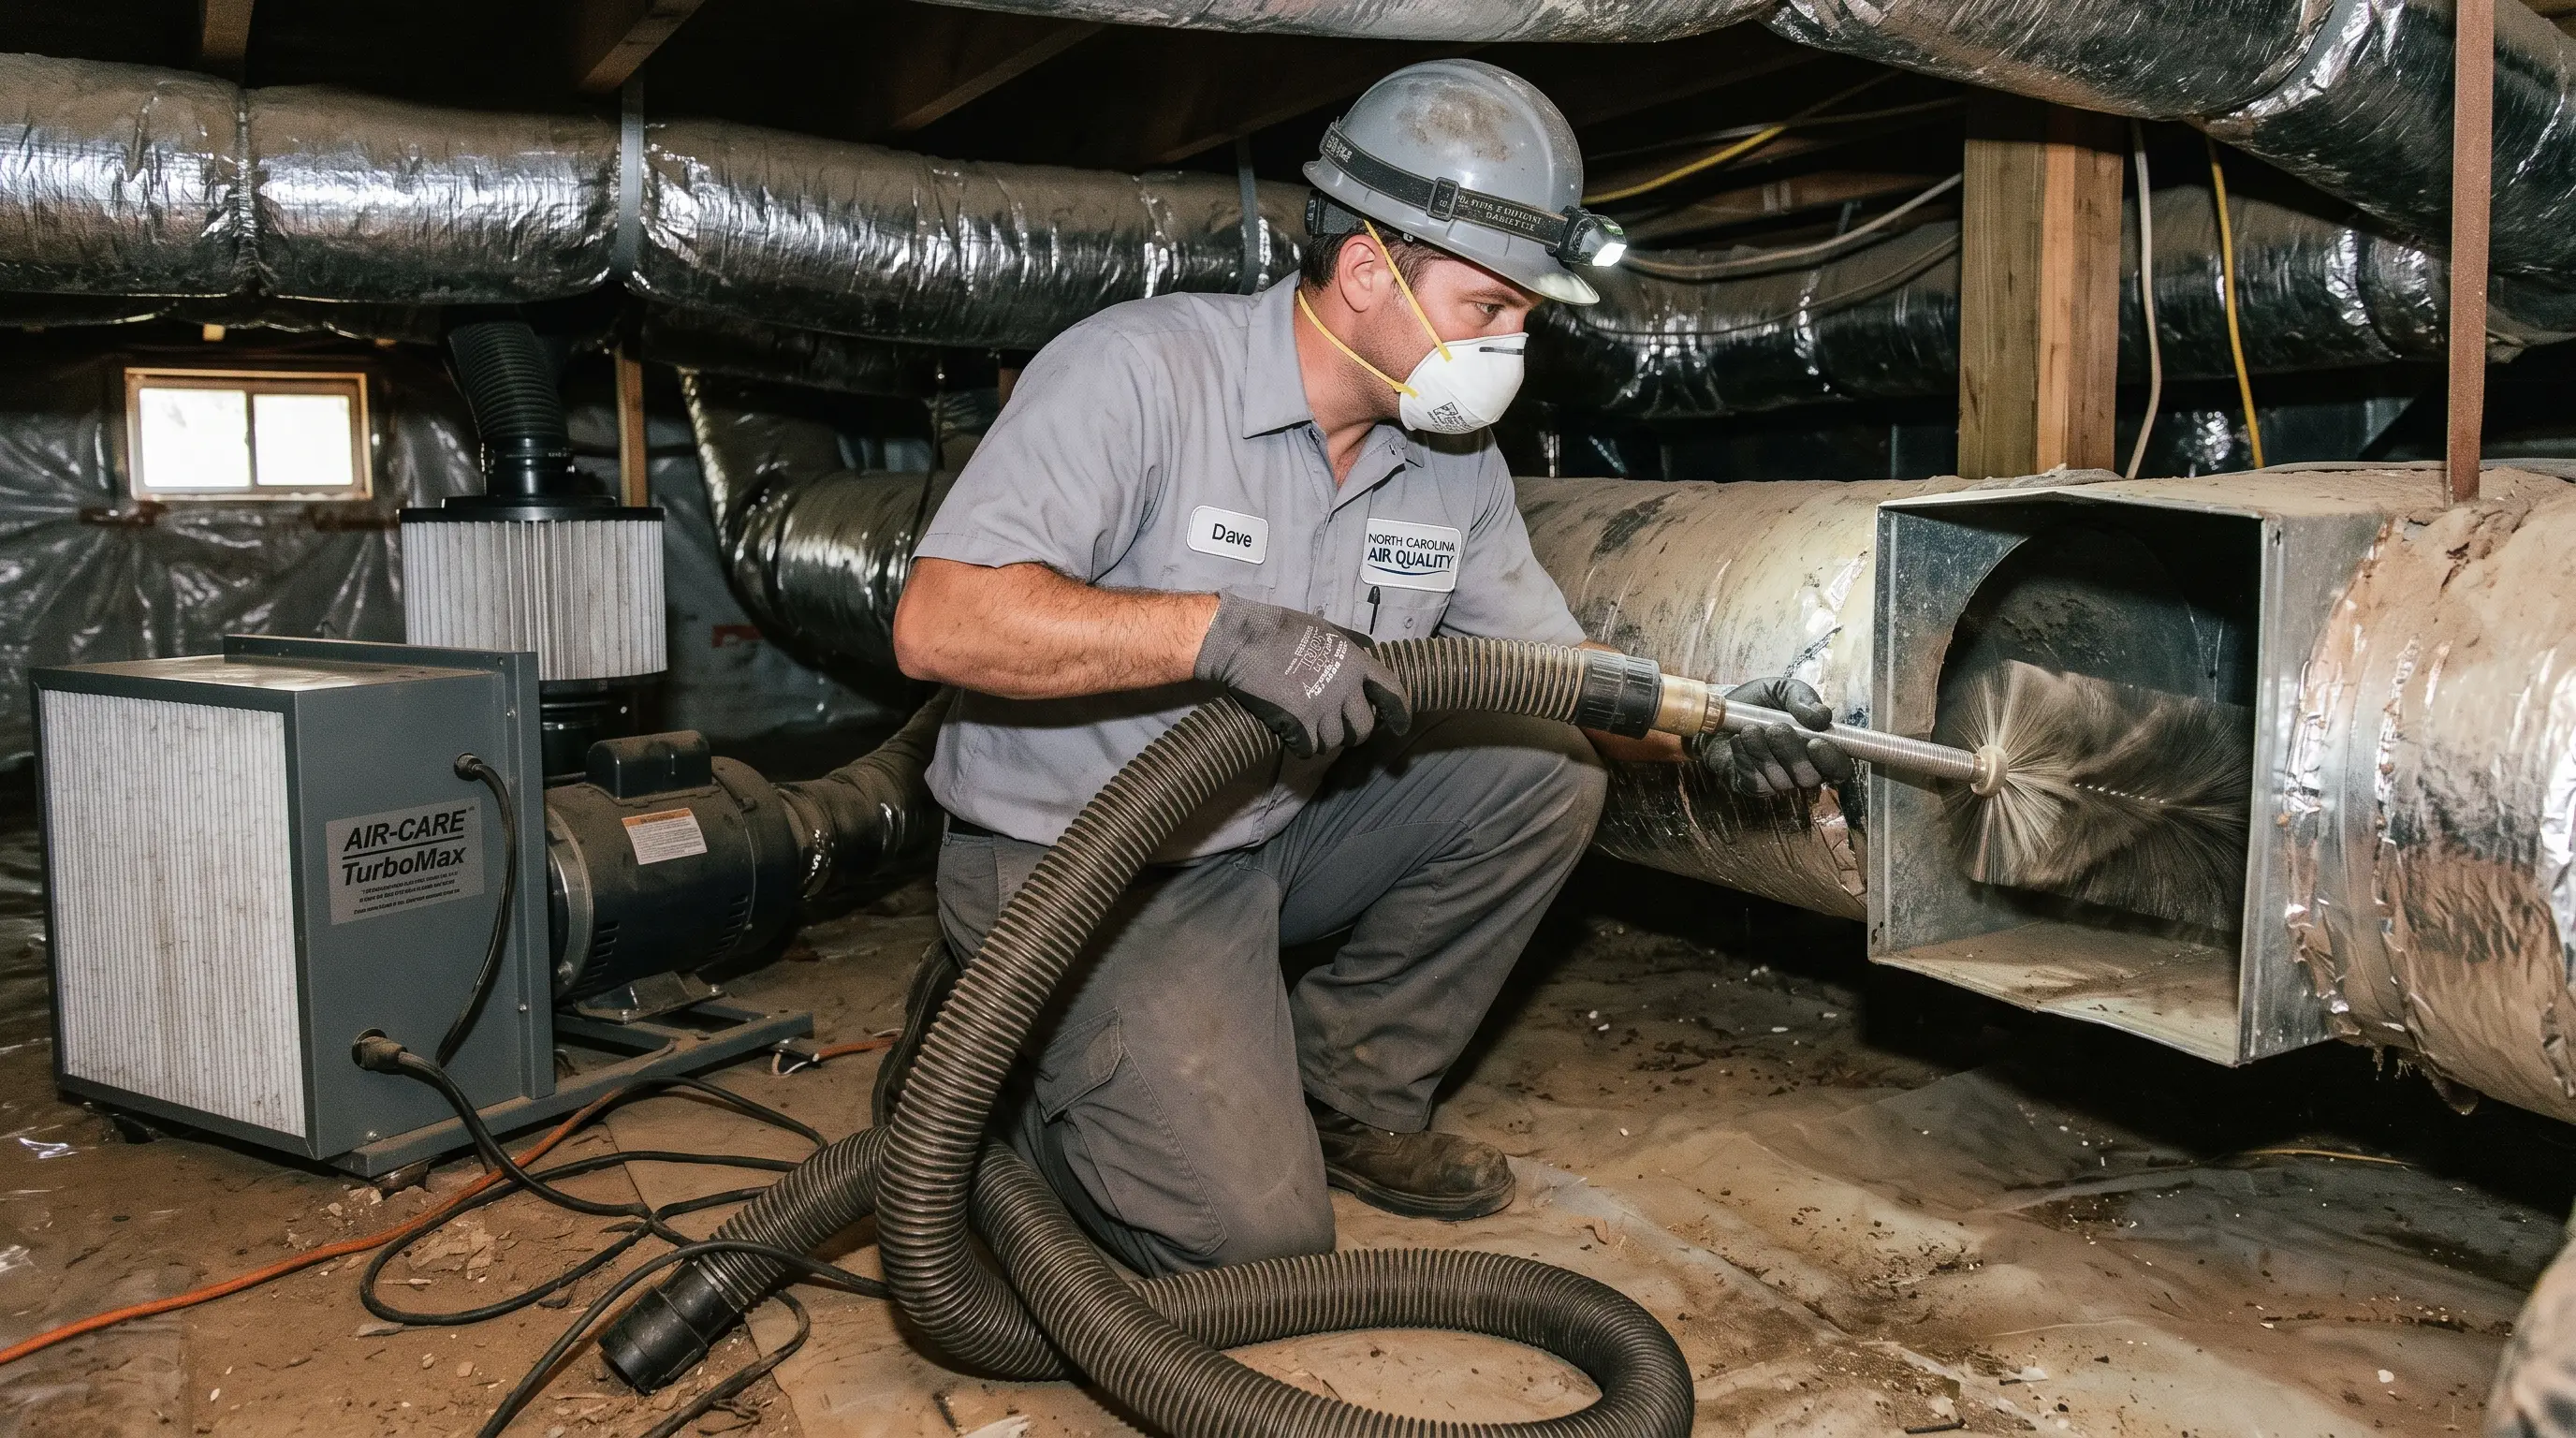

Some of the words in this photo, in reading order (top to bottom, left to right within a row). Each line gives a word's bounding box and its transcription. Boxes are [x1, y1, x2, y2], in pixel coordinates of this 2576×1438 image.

[1212, 523, 1251, 548] Dave
[1368, 534, 1403, 547] NORTH
[1406, 536, 1456, 552] CAROLINA
[1368, 548, 1392, 564] AIR
[1395, 550, 1455, 569] QUALITY
[343, 809, 467, 852] AIR-CARE
[342, 847, 467, 887] TurboMax
